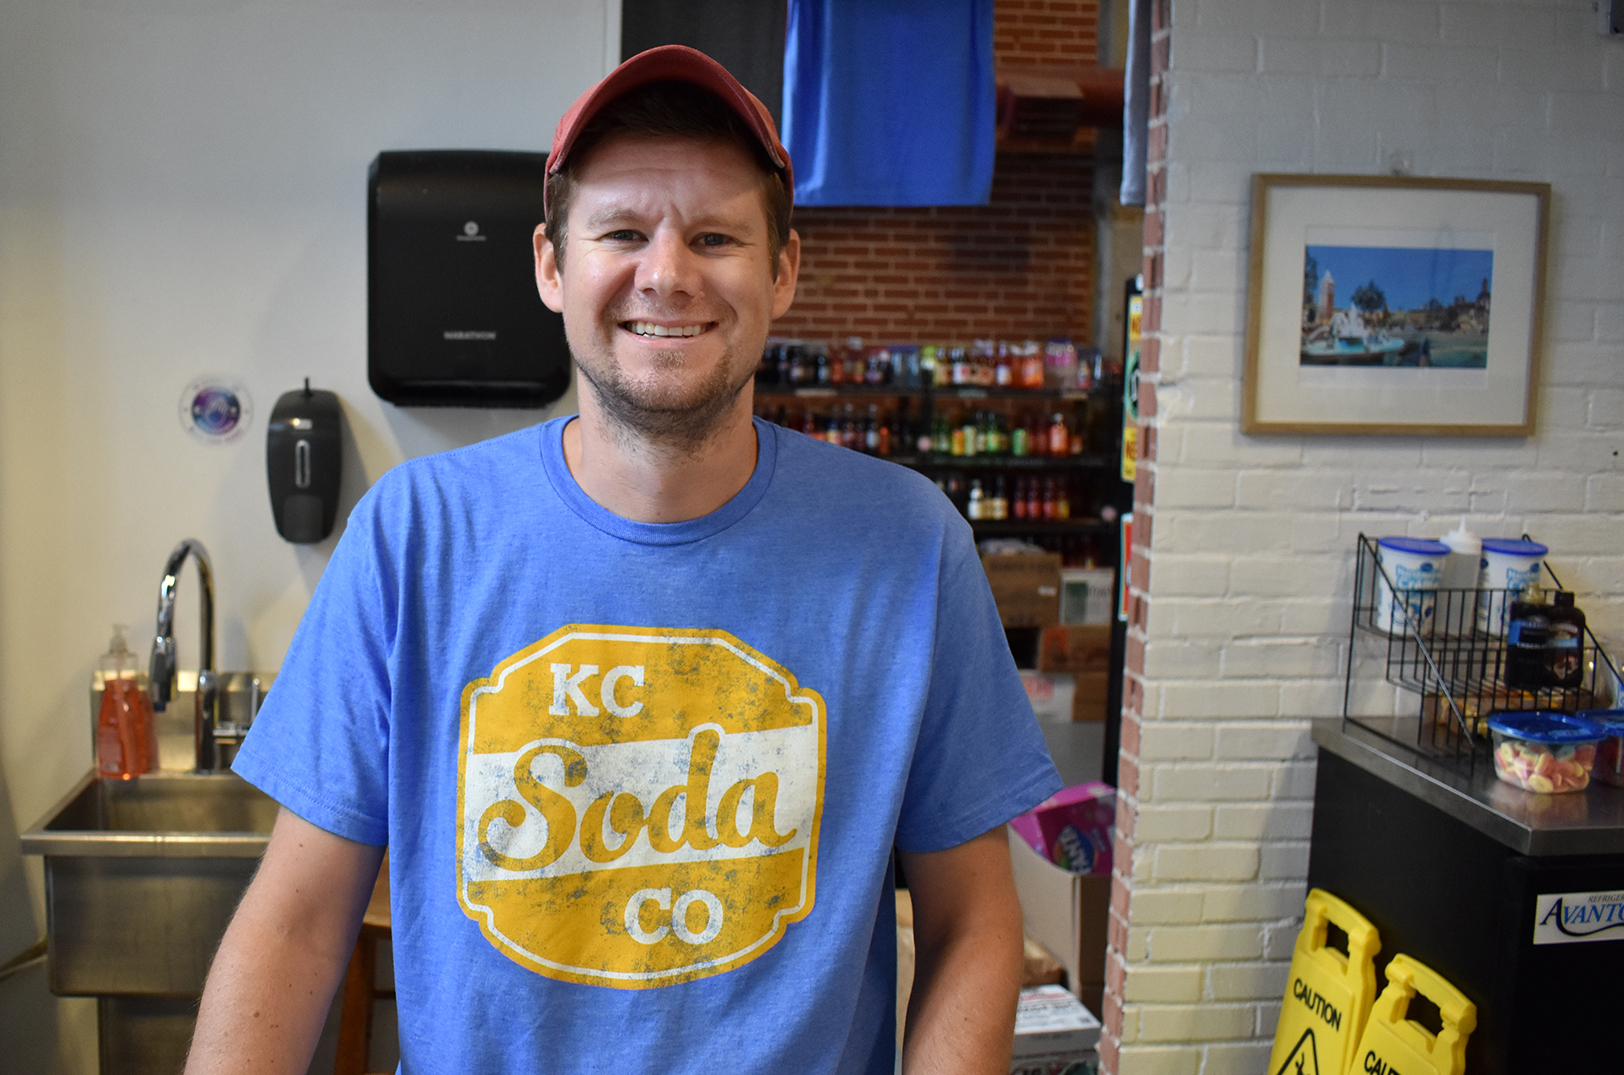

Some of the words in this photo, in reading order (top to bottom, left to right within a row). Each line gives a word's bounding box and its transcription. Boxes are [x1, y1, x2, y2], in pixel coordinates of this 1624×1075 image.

[548, 662, 645, 718] KC
[477, 727, 798, 872] Soda
[624, 886, 724, 945] CO
[1293, 978, 1342, 1032] CAUTION
